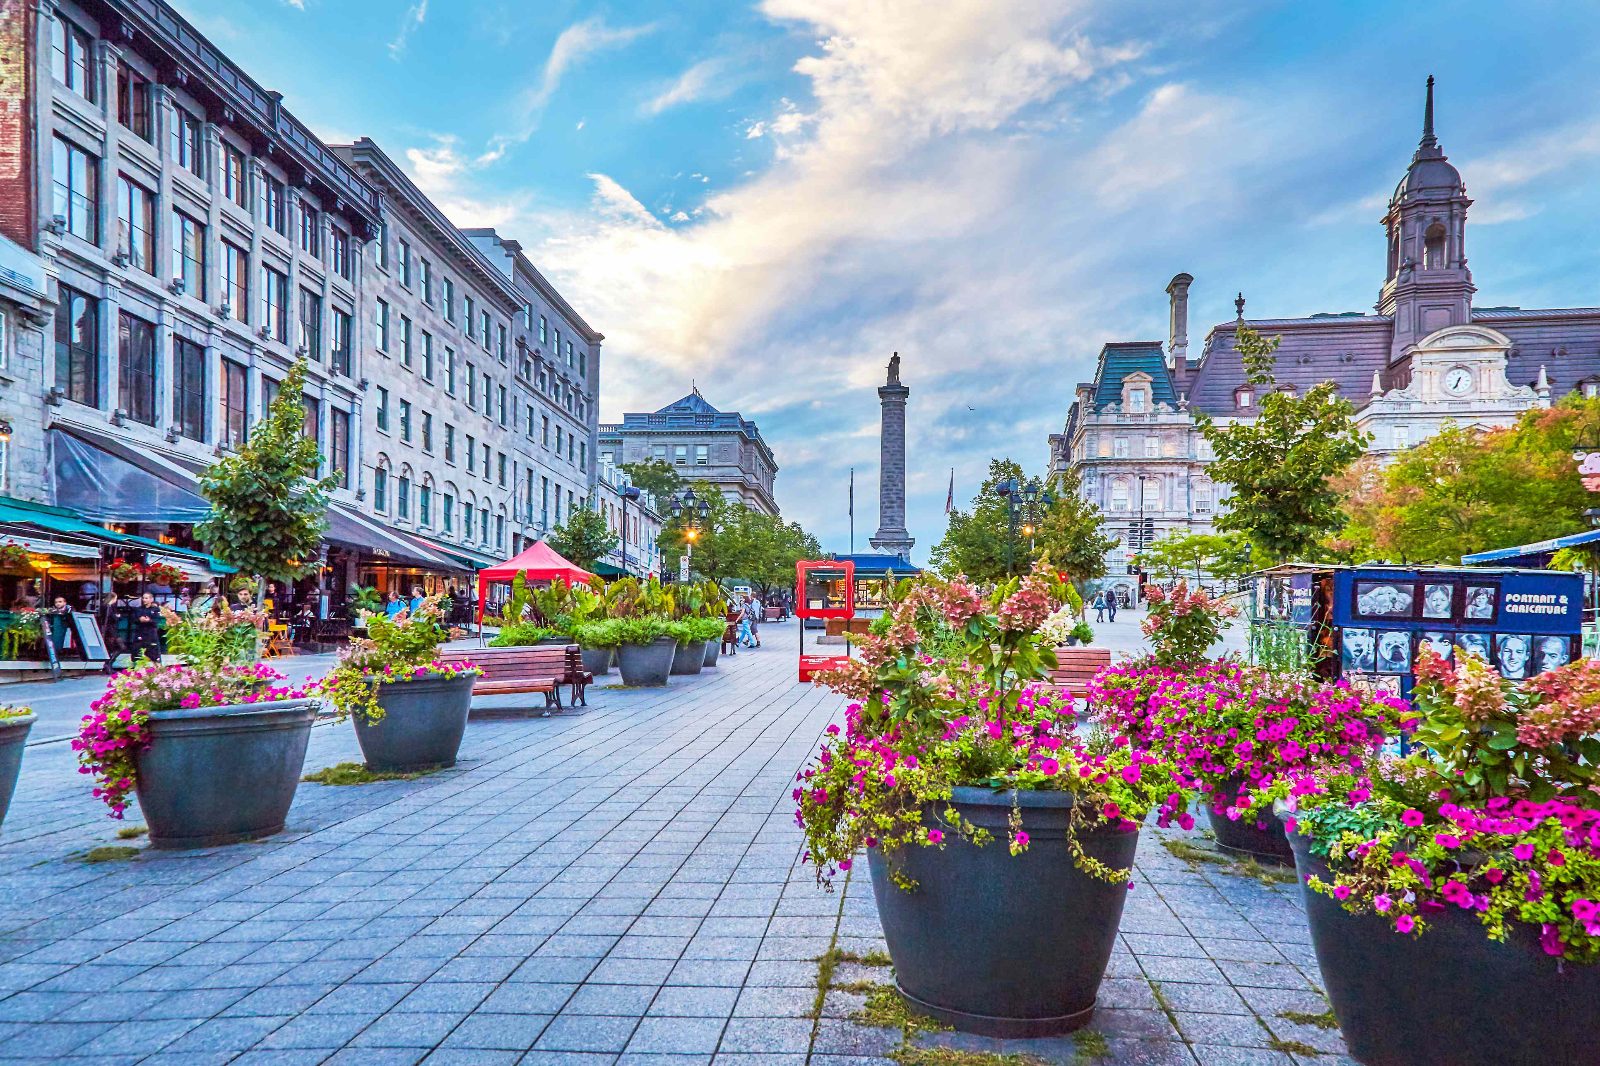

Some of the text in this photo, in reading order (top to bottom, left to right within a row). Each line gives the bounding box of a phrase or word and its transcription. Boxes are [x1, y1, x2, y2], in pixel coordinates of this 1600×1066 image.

[1505, 593, 1568, 604] PORTRAIT &
[1505, 604, 1568, 615] CARICATURE
